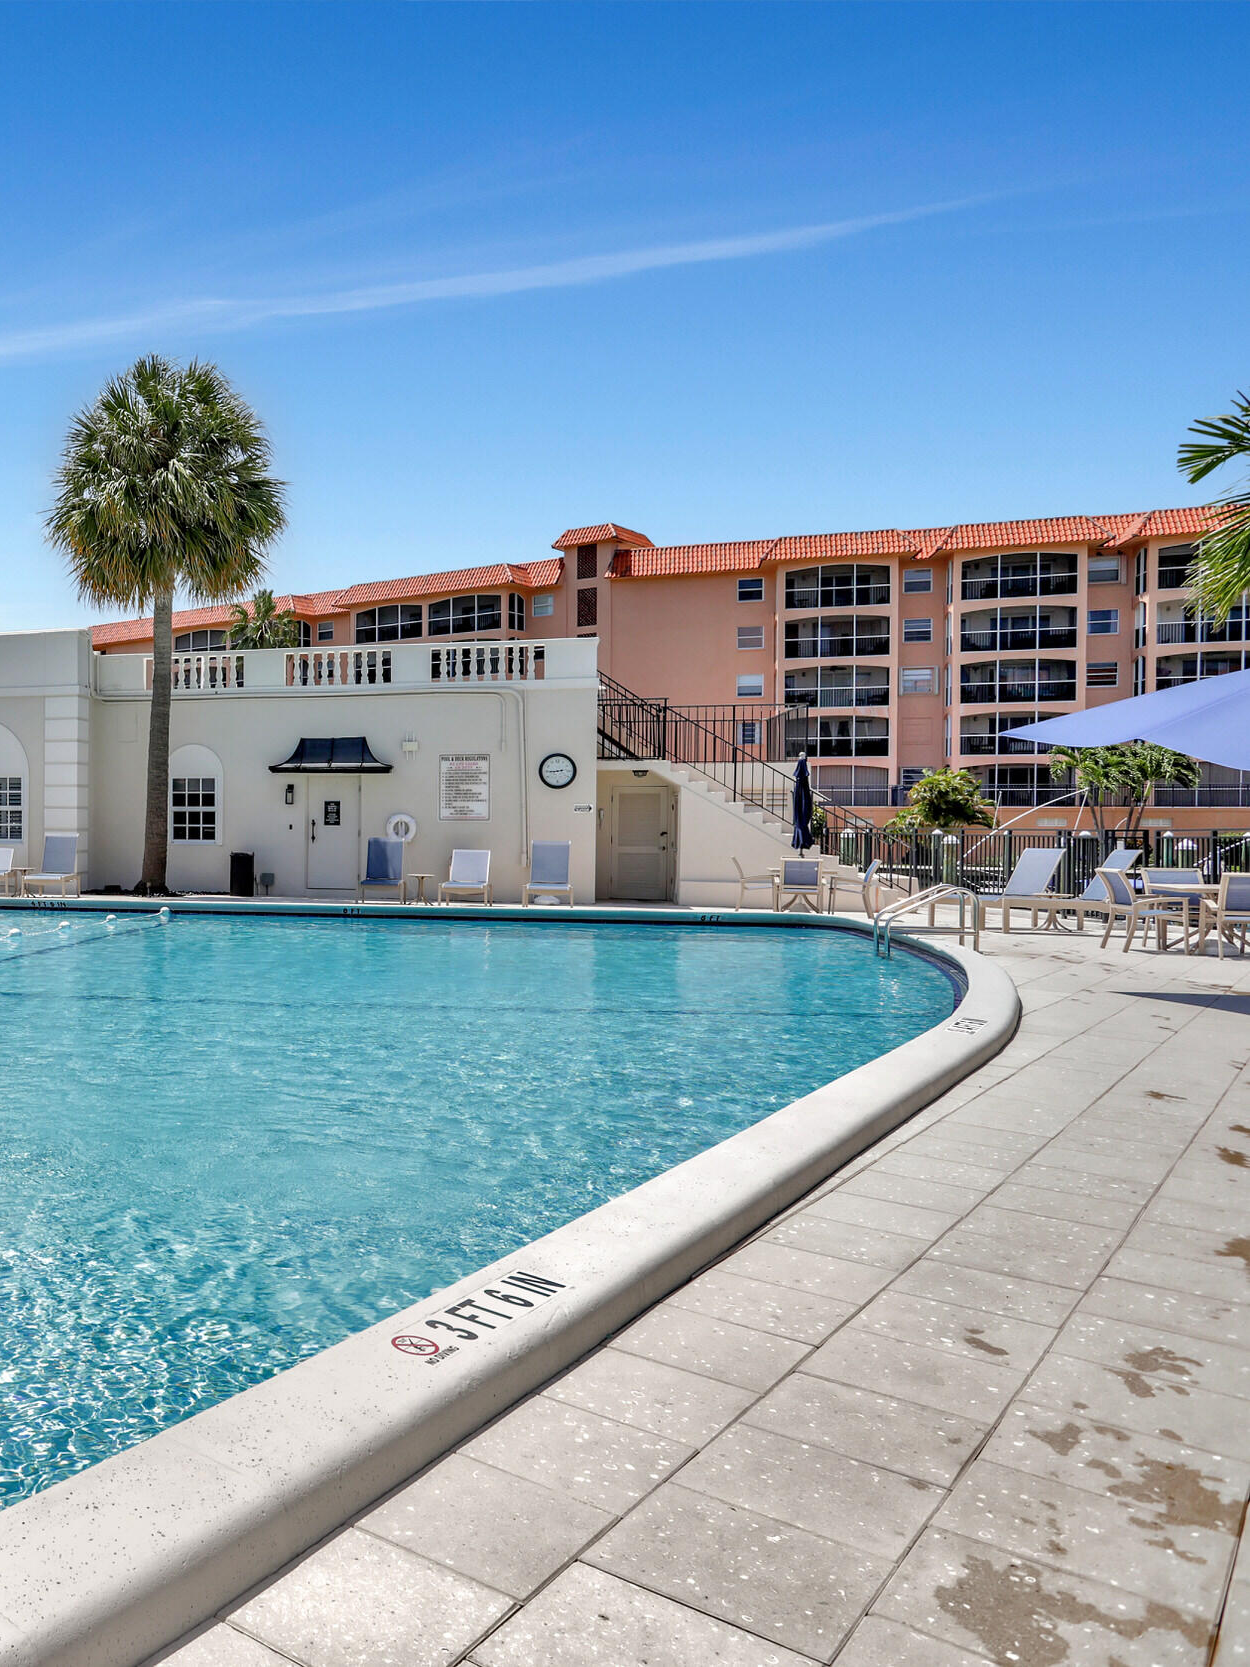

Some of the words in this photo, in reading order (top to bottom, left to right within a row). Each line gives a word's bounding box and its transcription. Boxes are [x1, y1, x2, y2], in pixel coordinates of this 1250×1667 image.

[500, 1271, 567, 1298] IN
[483, 1289, 535, 1308] 6
[444, 1298, 513, 1330] FT
[425, 1319, 479, 1341] 3
[425, 1357, 440, 1366] NO
[434, 1345, 460, 1360] DIVING
